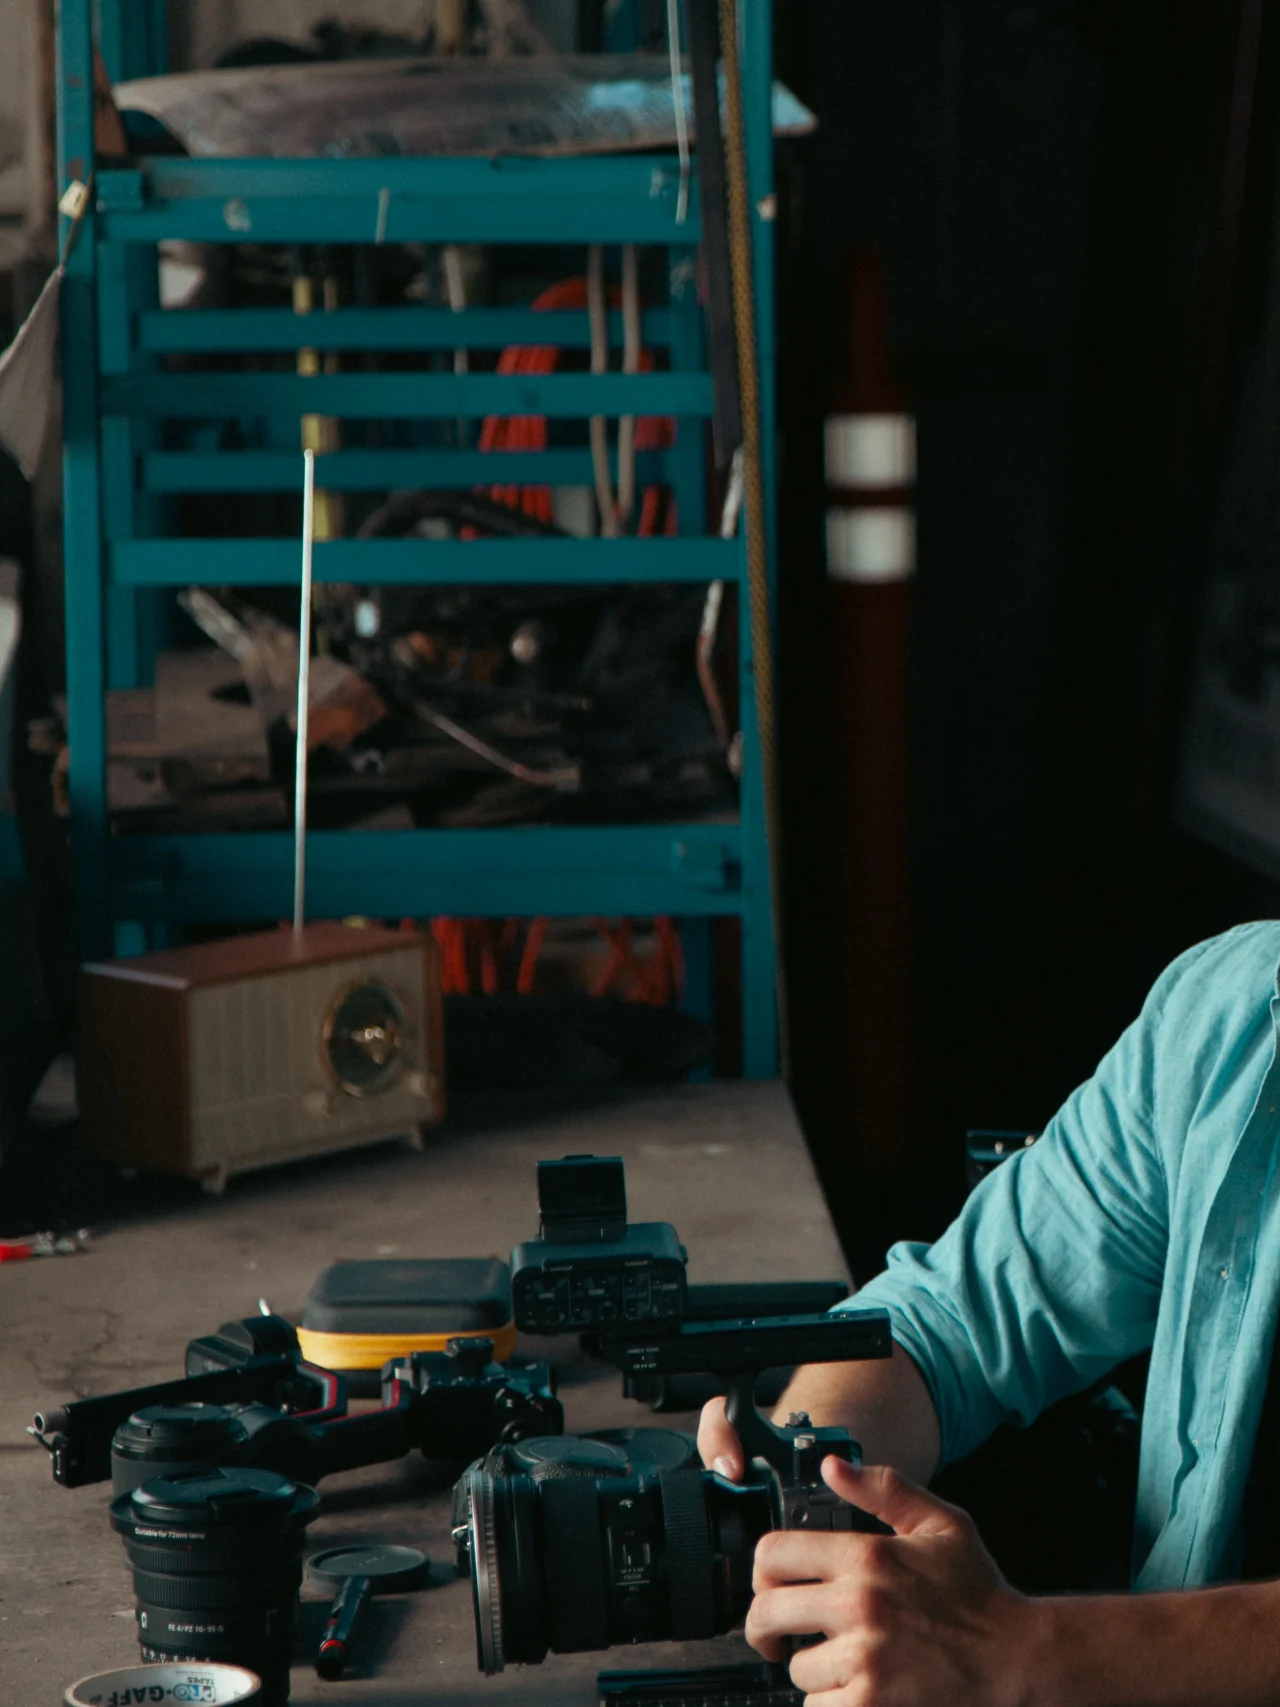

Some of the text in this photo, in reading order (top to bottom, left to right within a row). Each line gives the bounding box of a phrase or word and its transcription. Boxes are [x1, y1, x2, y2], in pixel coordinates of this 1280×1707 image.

[134, 1526, 157, 1537] Suitable
[158, 1530, 167, 1538] for
[168, 1531, 188, 1539] 72mm
[168, 1623, 176, 1632] FE
[176, 1623, 194, 1633] 4/PZ
[195, 1624, 216, 1633] 16-35
[187, 1676, 215, 1685] TAPES
